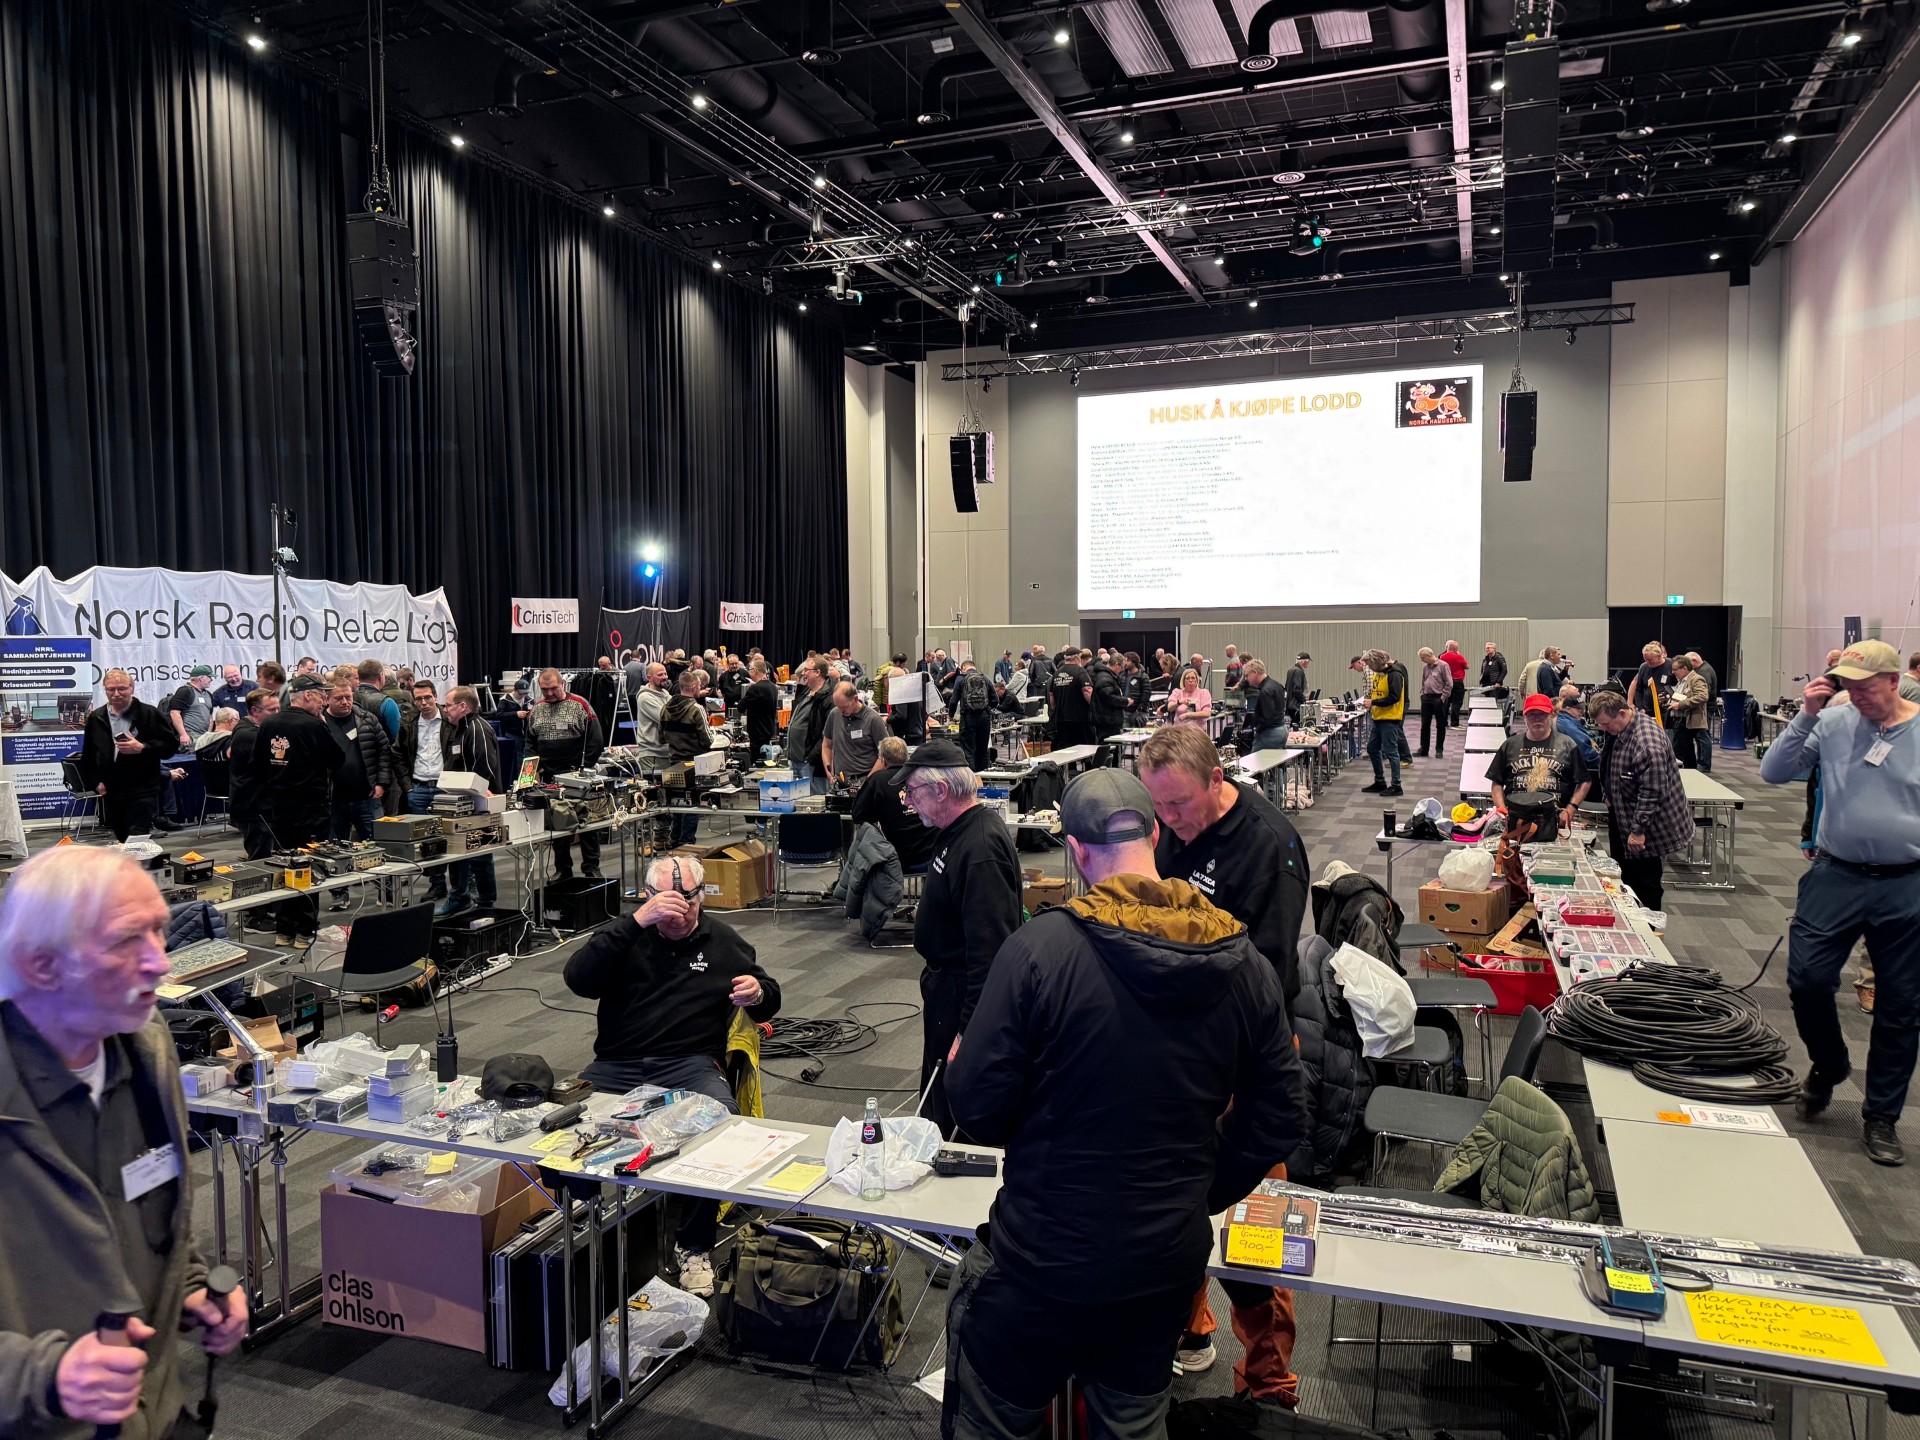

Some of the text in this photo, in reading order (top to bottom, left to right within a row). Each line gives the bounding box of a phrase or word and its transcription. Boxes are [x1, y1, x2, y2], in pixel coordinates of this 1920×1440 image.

[1149, 391, 1362, 424] HUSK Å KJØPE LODD
[74, 599, 459, 654] Norsk Radio Relæ Liga
[523, 608, 575, 625] ChrisTech
[727, 611, 762, 625] ChrisTech
[412, 660, 456, 681] Norge
[1510, 758, 1531, 774] JACK
[328, 1269, 374, 1301] clas
[328, 1295, 405, 1333] ohlson
[1693, 1293, 1752, 1307] MONO
[1759, 1300, 1827, 1316] BAND
[1698, 1303, 1735, 1313] ikke
